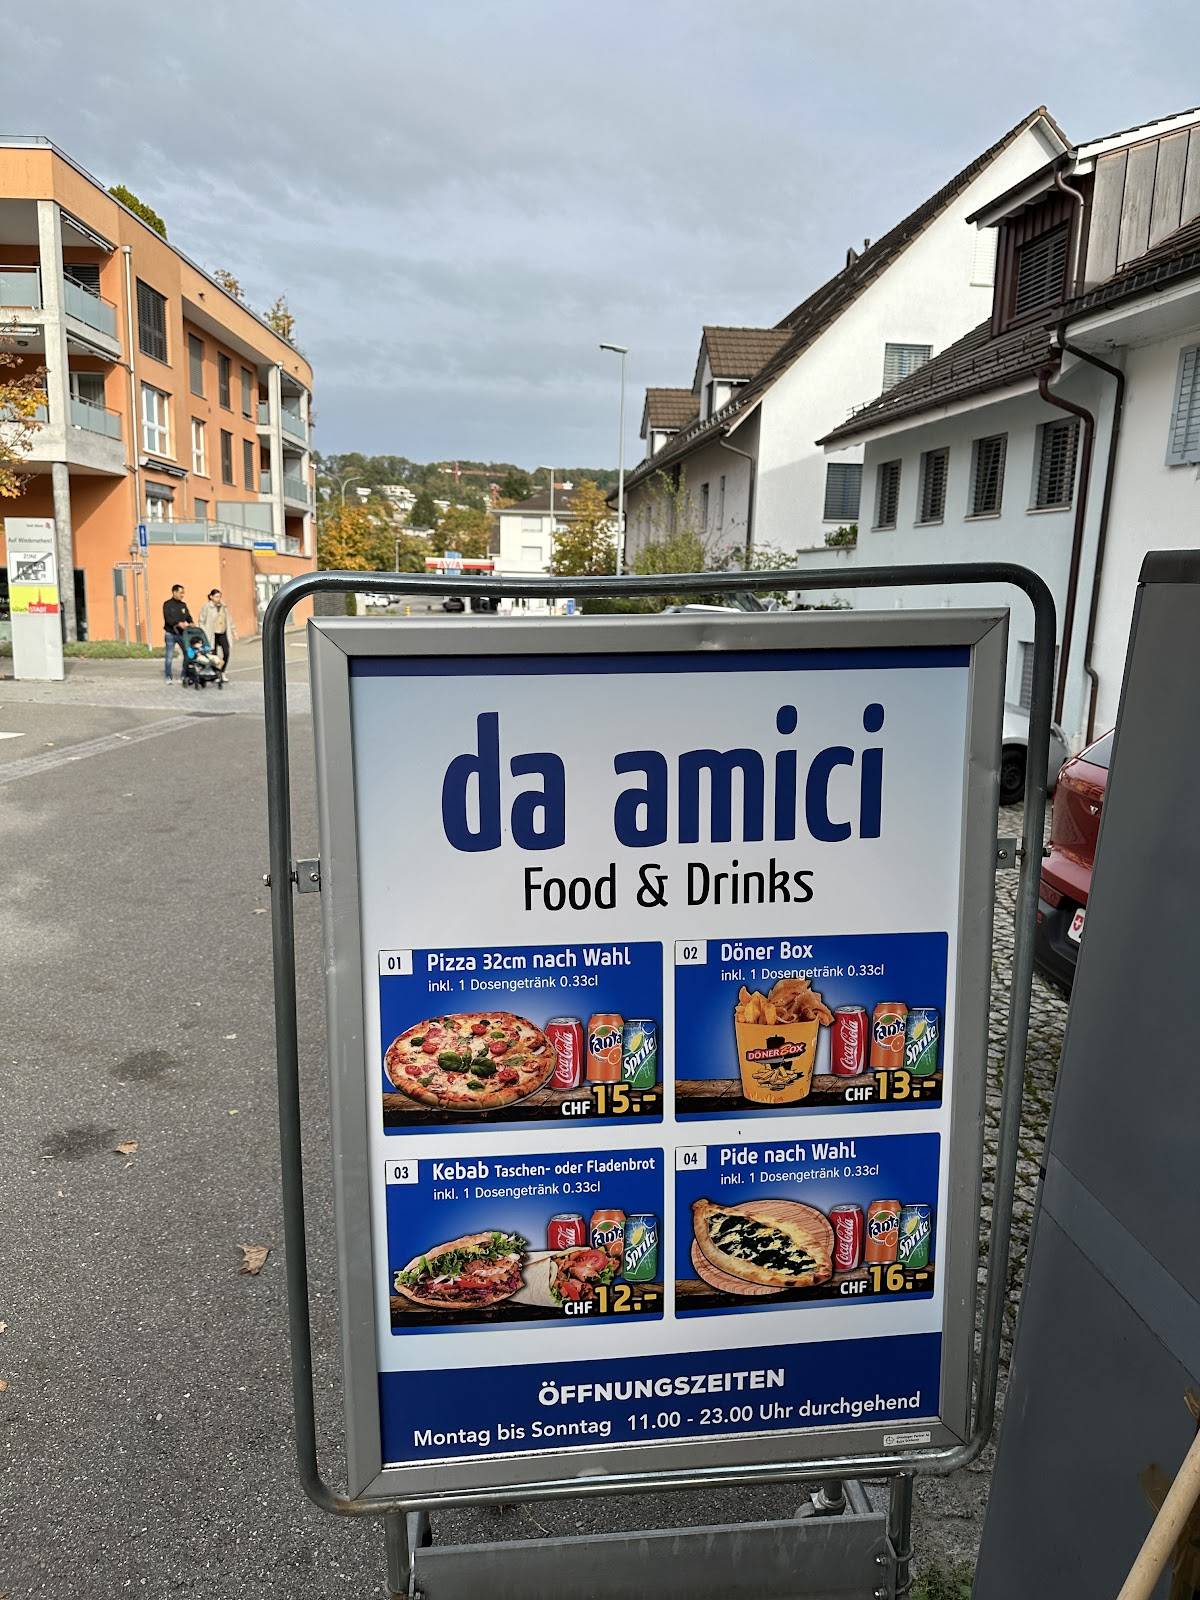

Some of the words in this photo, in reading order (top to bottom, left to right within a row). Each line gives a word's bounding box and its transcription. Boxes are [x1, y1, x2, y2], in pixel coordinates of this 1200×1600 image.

[442, 712, 566, 852] da
[614, 703, 885, 848] amici
[524, 863, 617, 911] Food
[636, 864, 668, 908] &
[687, 858, 814, 906] Drinks
[427, 953, 476, 972] Pizza
[482, 951, 526, 970] 32cm
[533, 951, 577, 969] nach
[583, 947, 631, 967] Wahl
[683, 947, 698, 960] 02
[721, 942, 774, 962] Döner
[780, 941, 813, 959] Box
[388, 957, 401, 970] 01
[721, 968, 745, 981] inkl.
[751, 969, 756, 980] 1
[761, 965, 843, 981] Dosengetränk
[847, 964, 884, 977] 0.33cl
[428, 979, 453, 992] inkl.
[459, 980, 465, 991] 1
[470, 976, 556, 992] Dosengetränk
[560, 975, 598, 988] 0.33cl
[874, 1016, 906, 1042] Fanta
[589, 1031, 623, 1054] Fanta
[906, 1025, 936, 1064] Sprite
[624, 1037, 655, 1078] Sprite
[845, 1087, 873, 1101] CHF
[562, 1101, 590, 1115] CHF
[684, 1152, 698, 1166] 04
[720, 1147, 758, 1166] Pide
[764, 1143, 805, 1163] nach
[812, 1141, 856, 1160] Wahl
[394, 1166, 409, 1179] 03
[432, 1161, 489, 1181] Kebab
[494, 1163, 551, 1178] Taschen-
[554, 1161, 583, 1175] oder
[586, 1157, 656, 1173] Fladenbrot
[720, 1172, 745, 1185] inkl.
[749, 1173, 755, 1184] 1
[760, 1167, 840, 1184] Dosengetränk
[843, 1164, 879, 1178] 0.33cl
[433, 1188, 458, 1200] inkl.
[464, 1188, 469, 1199] 1
[475, 1184, 559, 1200] Dosengetränk
[563, 1181, 601, 1194] 0.33cl
[591, 1226, 624, 1249] Fanta
[869, 1215, 899, 1239] Fanta
[625, 1231, 656, 1271] Sprite
[900, 1220, 929, 1259] Sprite
[840, 1281, 867, 1295] CHF
[564, 1301, 593, 1315] CHF
[538, 1368, 785, 1406] ÖFFNUNGSZEITEN
[414, 1428, 490, 1446] Montag
[497, 1423, 525, 1440] bis
[531, 1419, 612, 1437] Sonntag
[628, 1411, 681, 1431] 11.00
[699, 1405, 752, 1425] 23.00
[759, 1401, 793, 1420] Uhr
[799, 1391, 920, 1417] durchgehend
